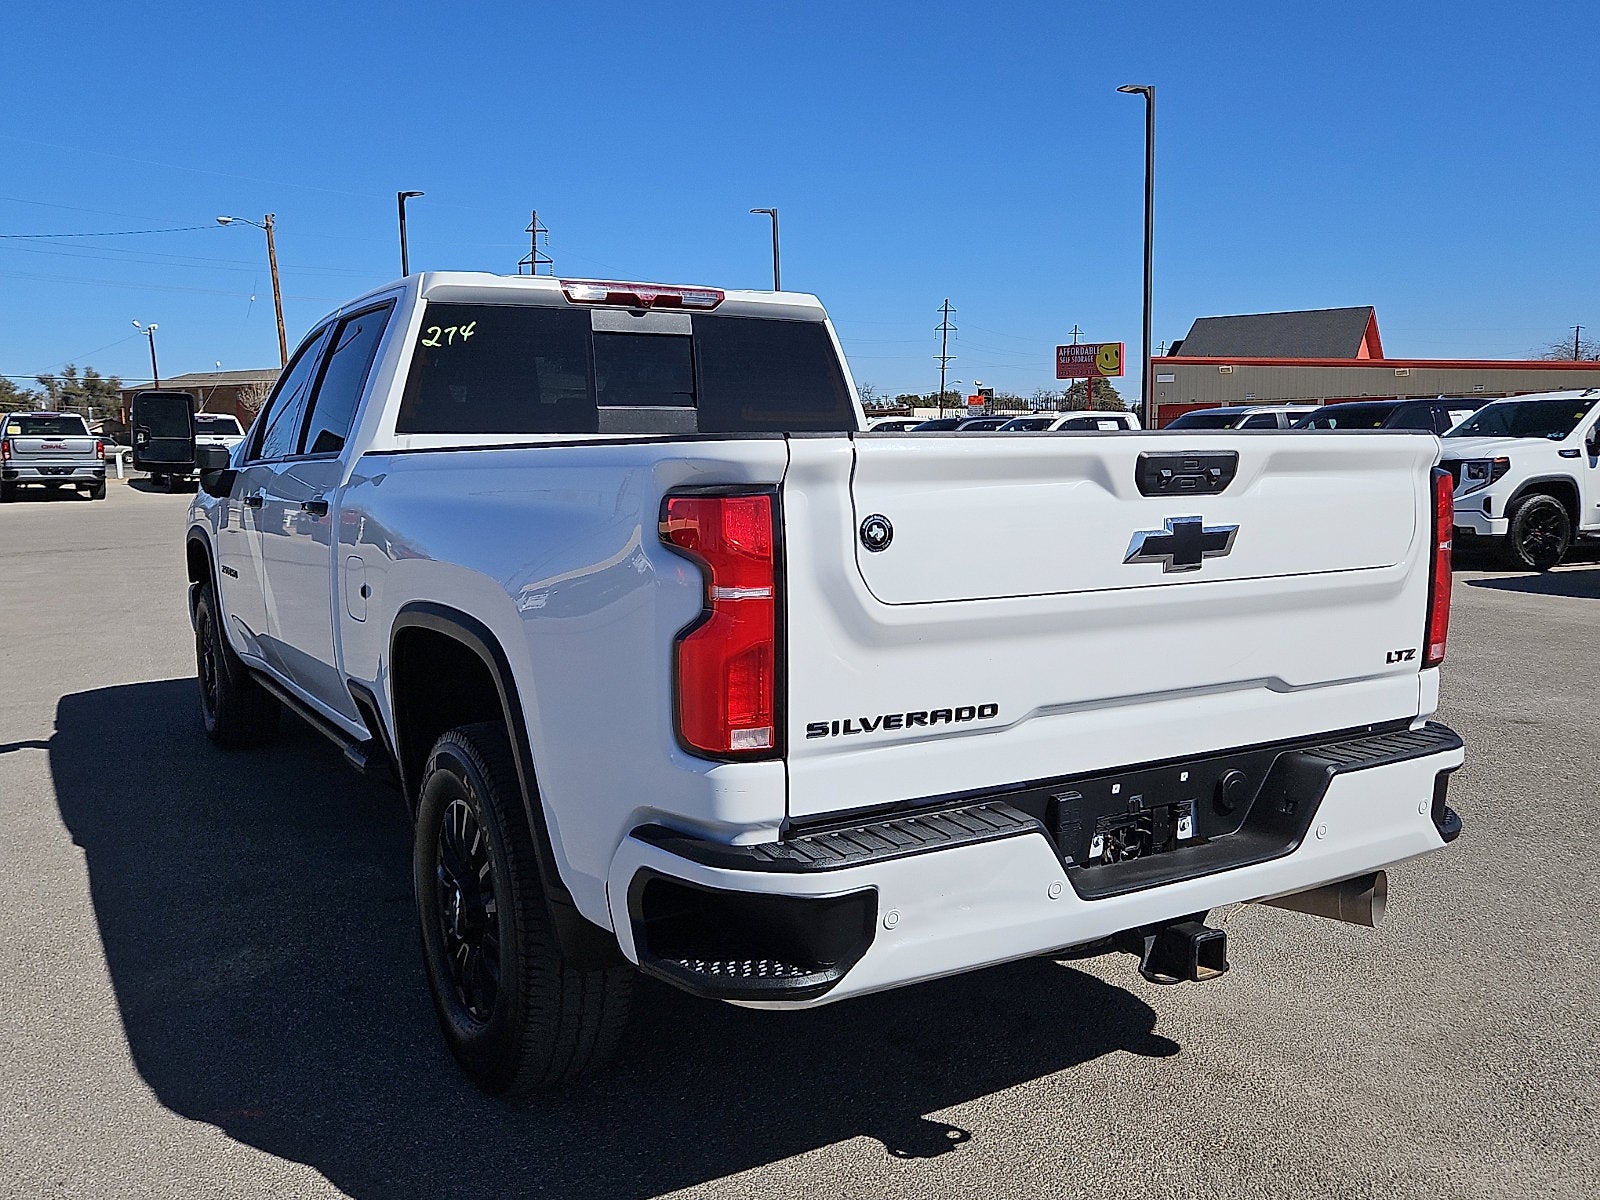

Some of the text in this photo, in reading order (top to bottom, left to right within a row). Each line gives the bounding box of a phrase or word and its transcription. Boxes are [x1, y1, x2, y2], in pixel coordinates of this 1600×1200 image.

[421, 321, 477, 347] 274
[1059, 346, 1100, 356] AFFORDABLE
[1060, 355, 1094, 364] SELF STORAGE
[1386, 648, 1417, 665] LTZ
[805, 703, 999, 740] SILVERADO
